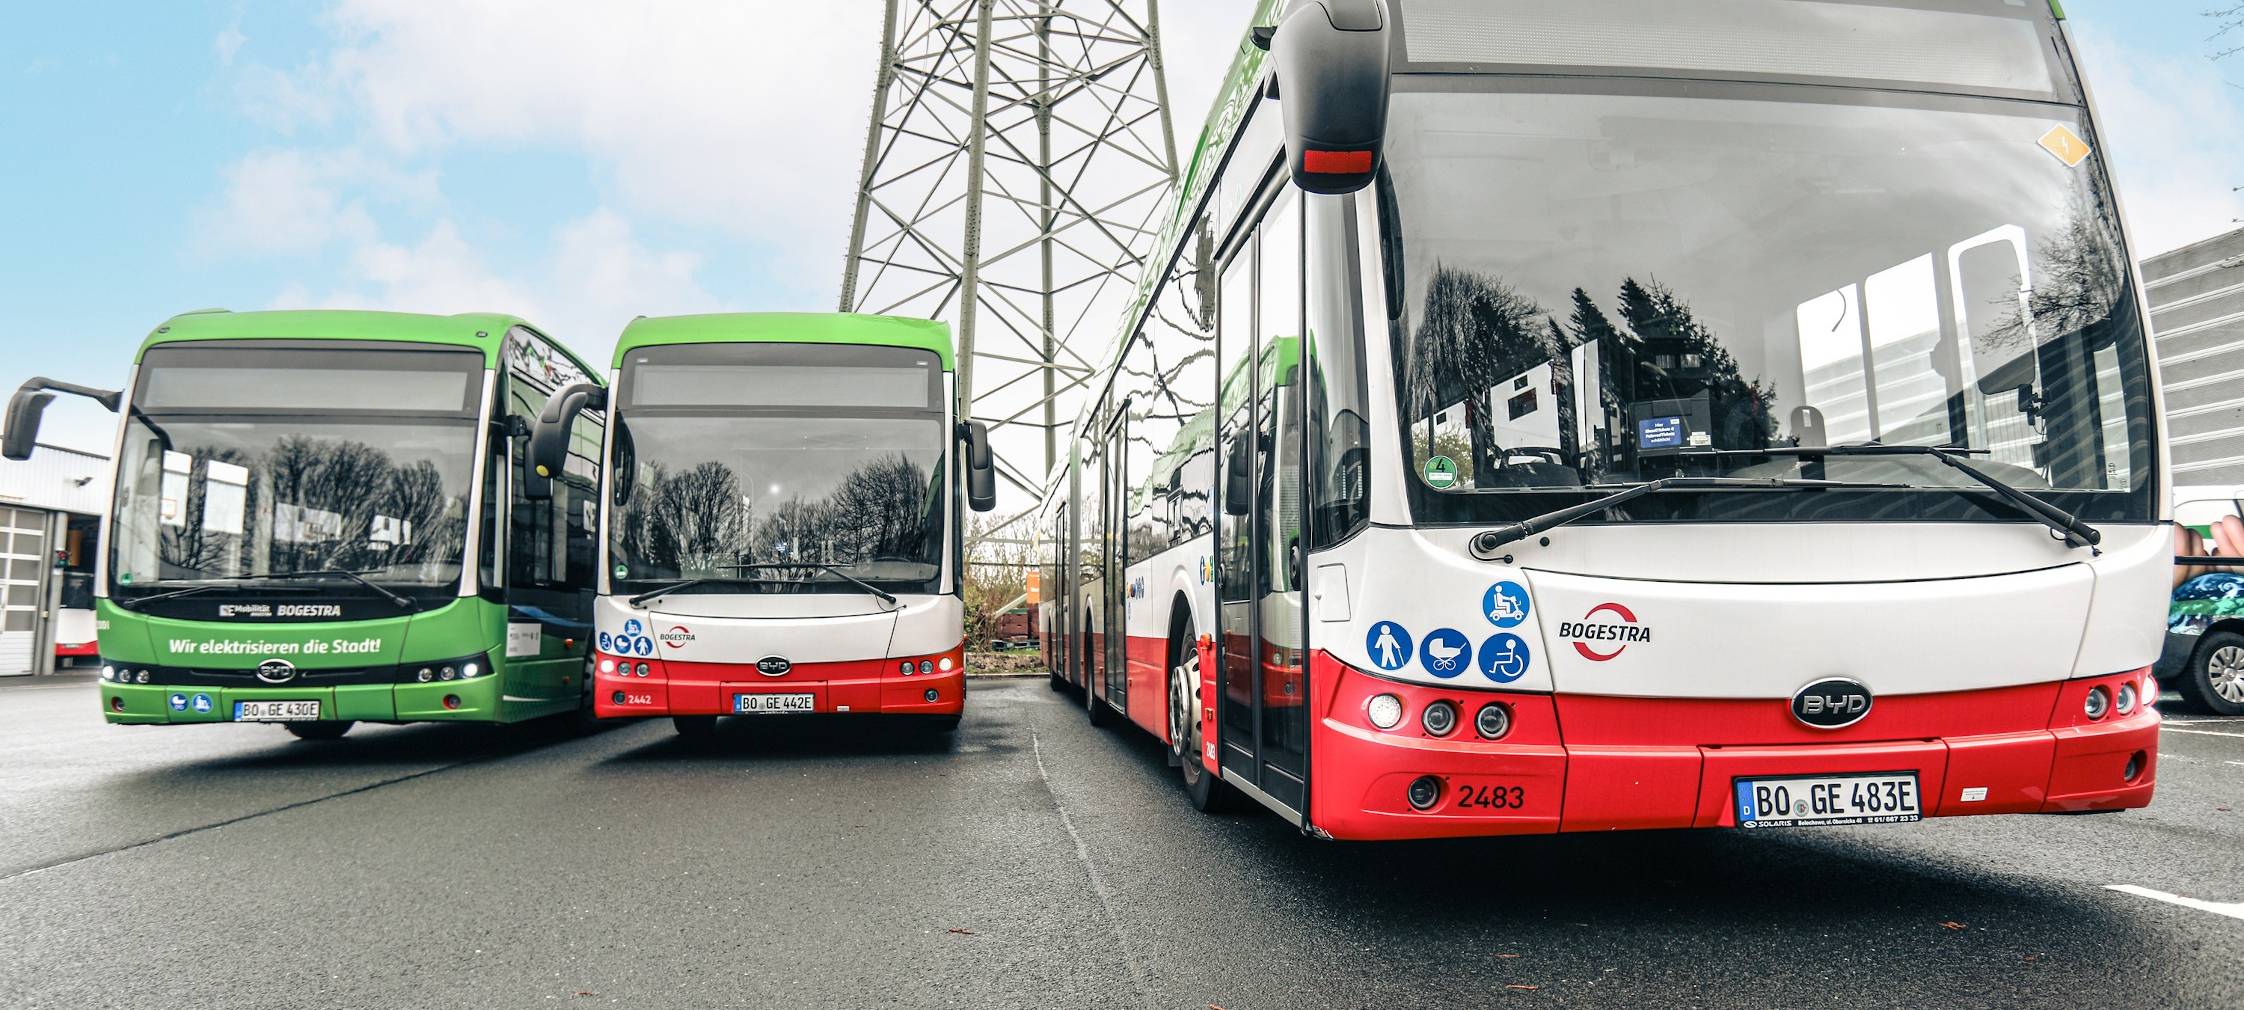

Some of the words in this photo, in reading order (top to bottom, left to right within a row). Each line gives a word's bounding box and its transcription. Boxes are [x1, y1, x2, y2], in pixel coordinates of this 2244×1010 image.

[1436, 458, 1446, 472] 4
[277, 605, 341, 616] BOGESTRA
[660, 633, 696, 641] BOGESTRA
[1559, 622, 1651, 643] BOGESTRA
[169, 639, 196, 653] Wir
[199, 639, 299, 654] elektrisieren
[303, 639, 329, 654] die
[332, 638, 381, 654] Stadt!
[260, 665, 291, 676] BYD
[760, 662, 788, 670] BYD
[628, 695, 652, 704] 2442
[743, 697, 758, 709] BO
[766, 697, 780, 709] GE
[783, 696, 812, 709] 442E
[1802, 694, 1866, 715] BYD
[243, 703, 260, 716] BO
[268, 703, 284, 716] GE
[286, 703, 318, 716] 430E
[1458, 785, 1525, 809] 2483
[1756, 785, 1791, 817] BO
[1811, 783, 1844, 815] GE
[1851, 781, 1915, 813] 483E
[1743, 806, 1750, 815] D
[1758, 820, 1792, 828] SOLARIS
